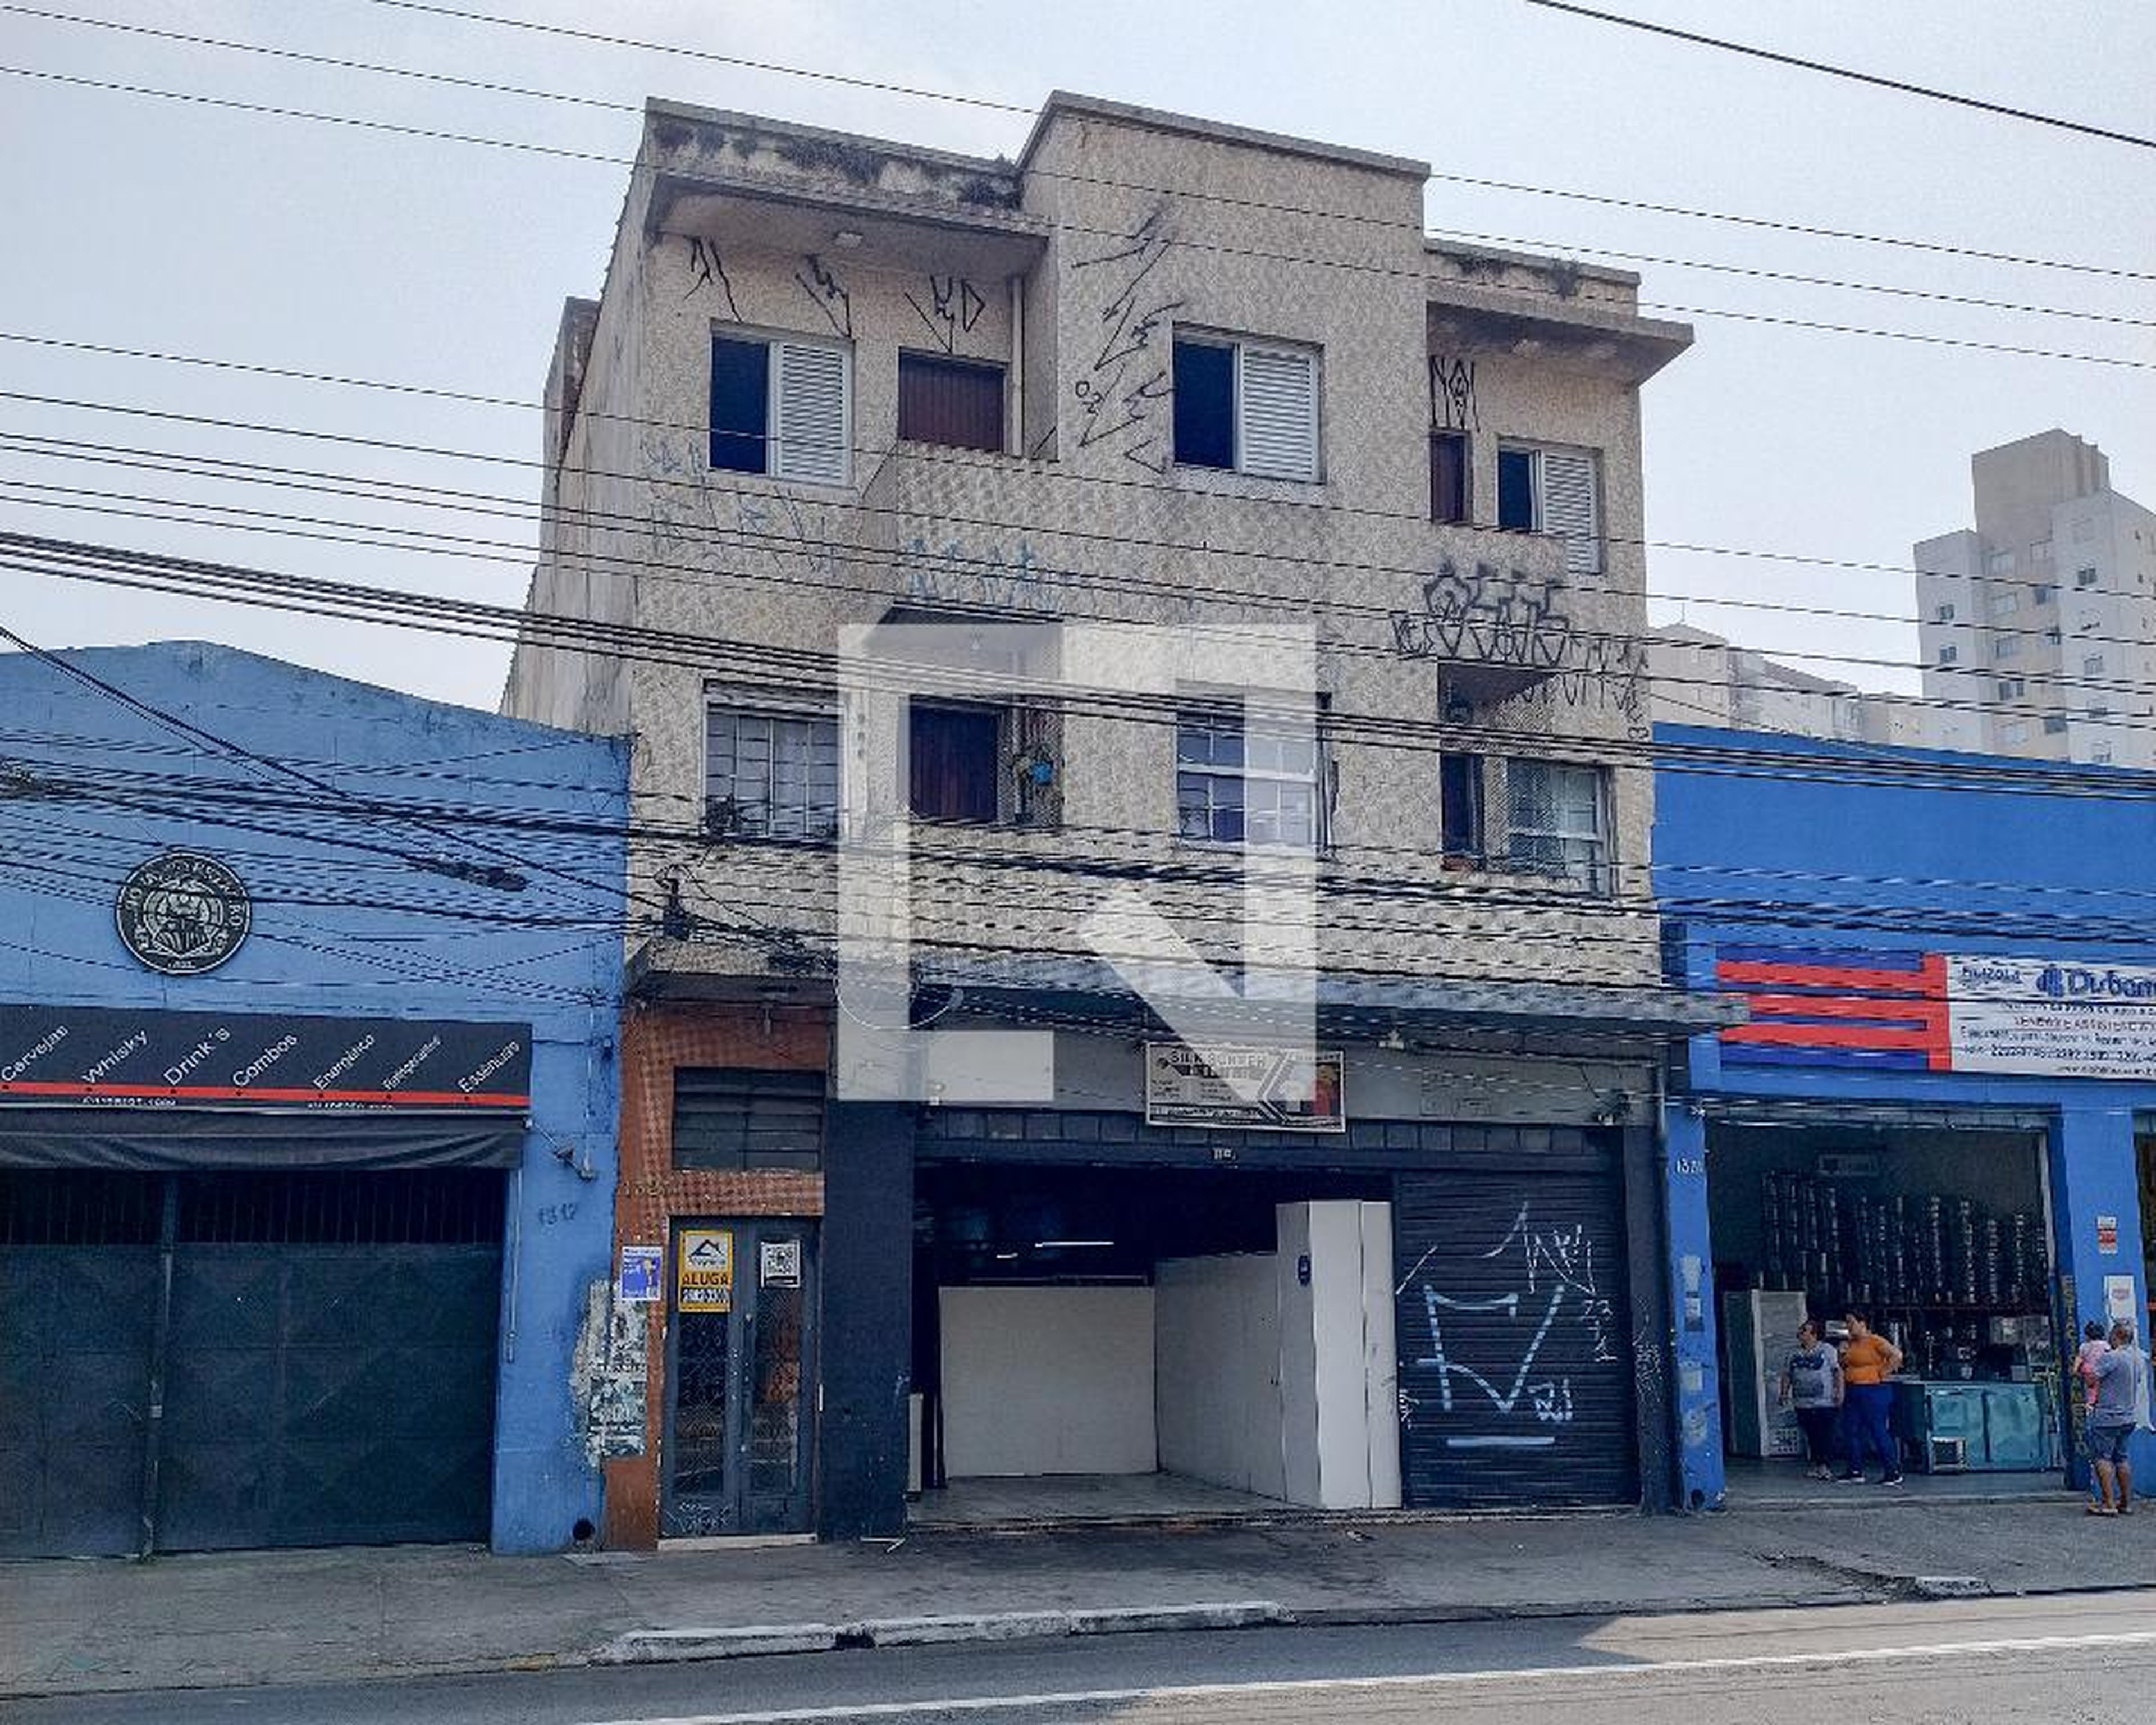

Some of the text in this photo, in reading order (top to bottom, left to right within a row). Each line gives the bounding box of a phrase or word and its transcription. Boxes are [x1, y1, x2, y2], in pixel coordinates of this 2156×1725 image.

[81, 1030, 148, 1084] Whisky
[232, 1034, 298, 1087] Combos
[682, 1272, 729, 1286] ALUGA
